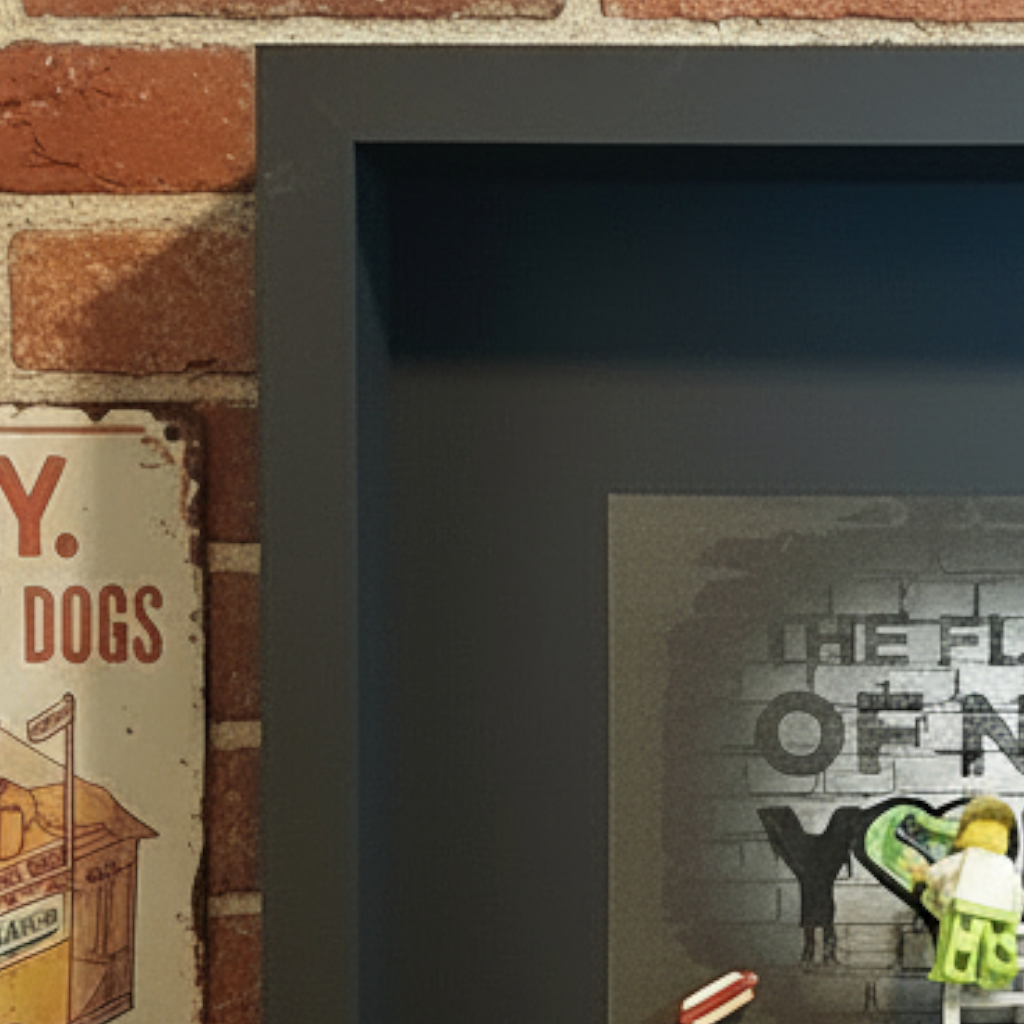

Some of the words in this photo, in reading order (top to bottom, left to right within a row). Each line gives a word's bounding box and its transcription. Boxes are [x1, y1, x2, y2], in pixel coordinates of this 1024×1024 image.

[0, 455, 78, 558] Y.
[24, 584, 164, 664] DOGS
[767, 614, 909, 666] THE
[755, 691, 923, 776] OF
